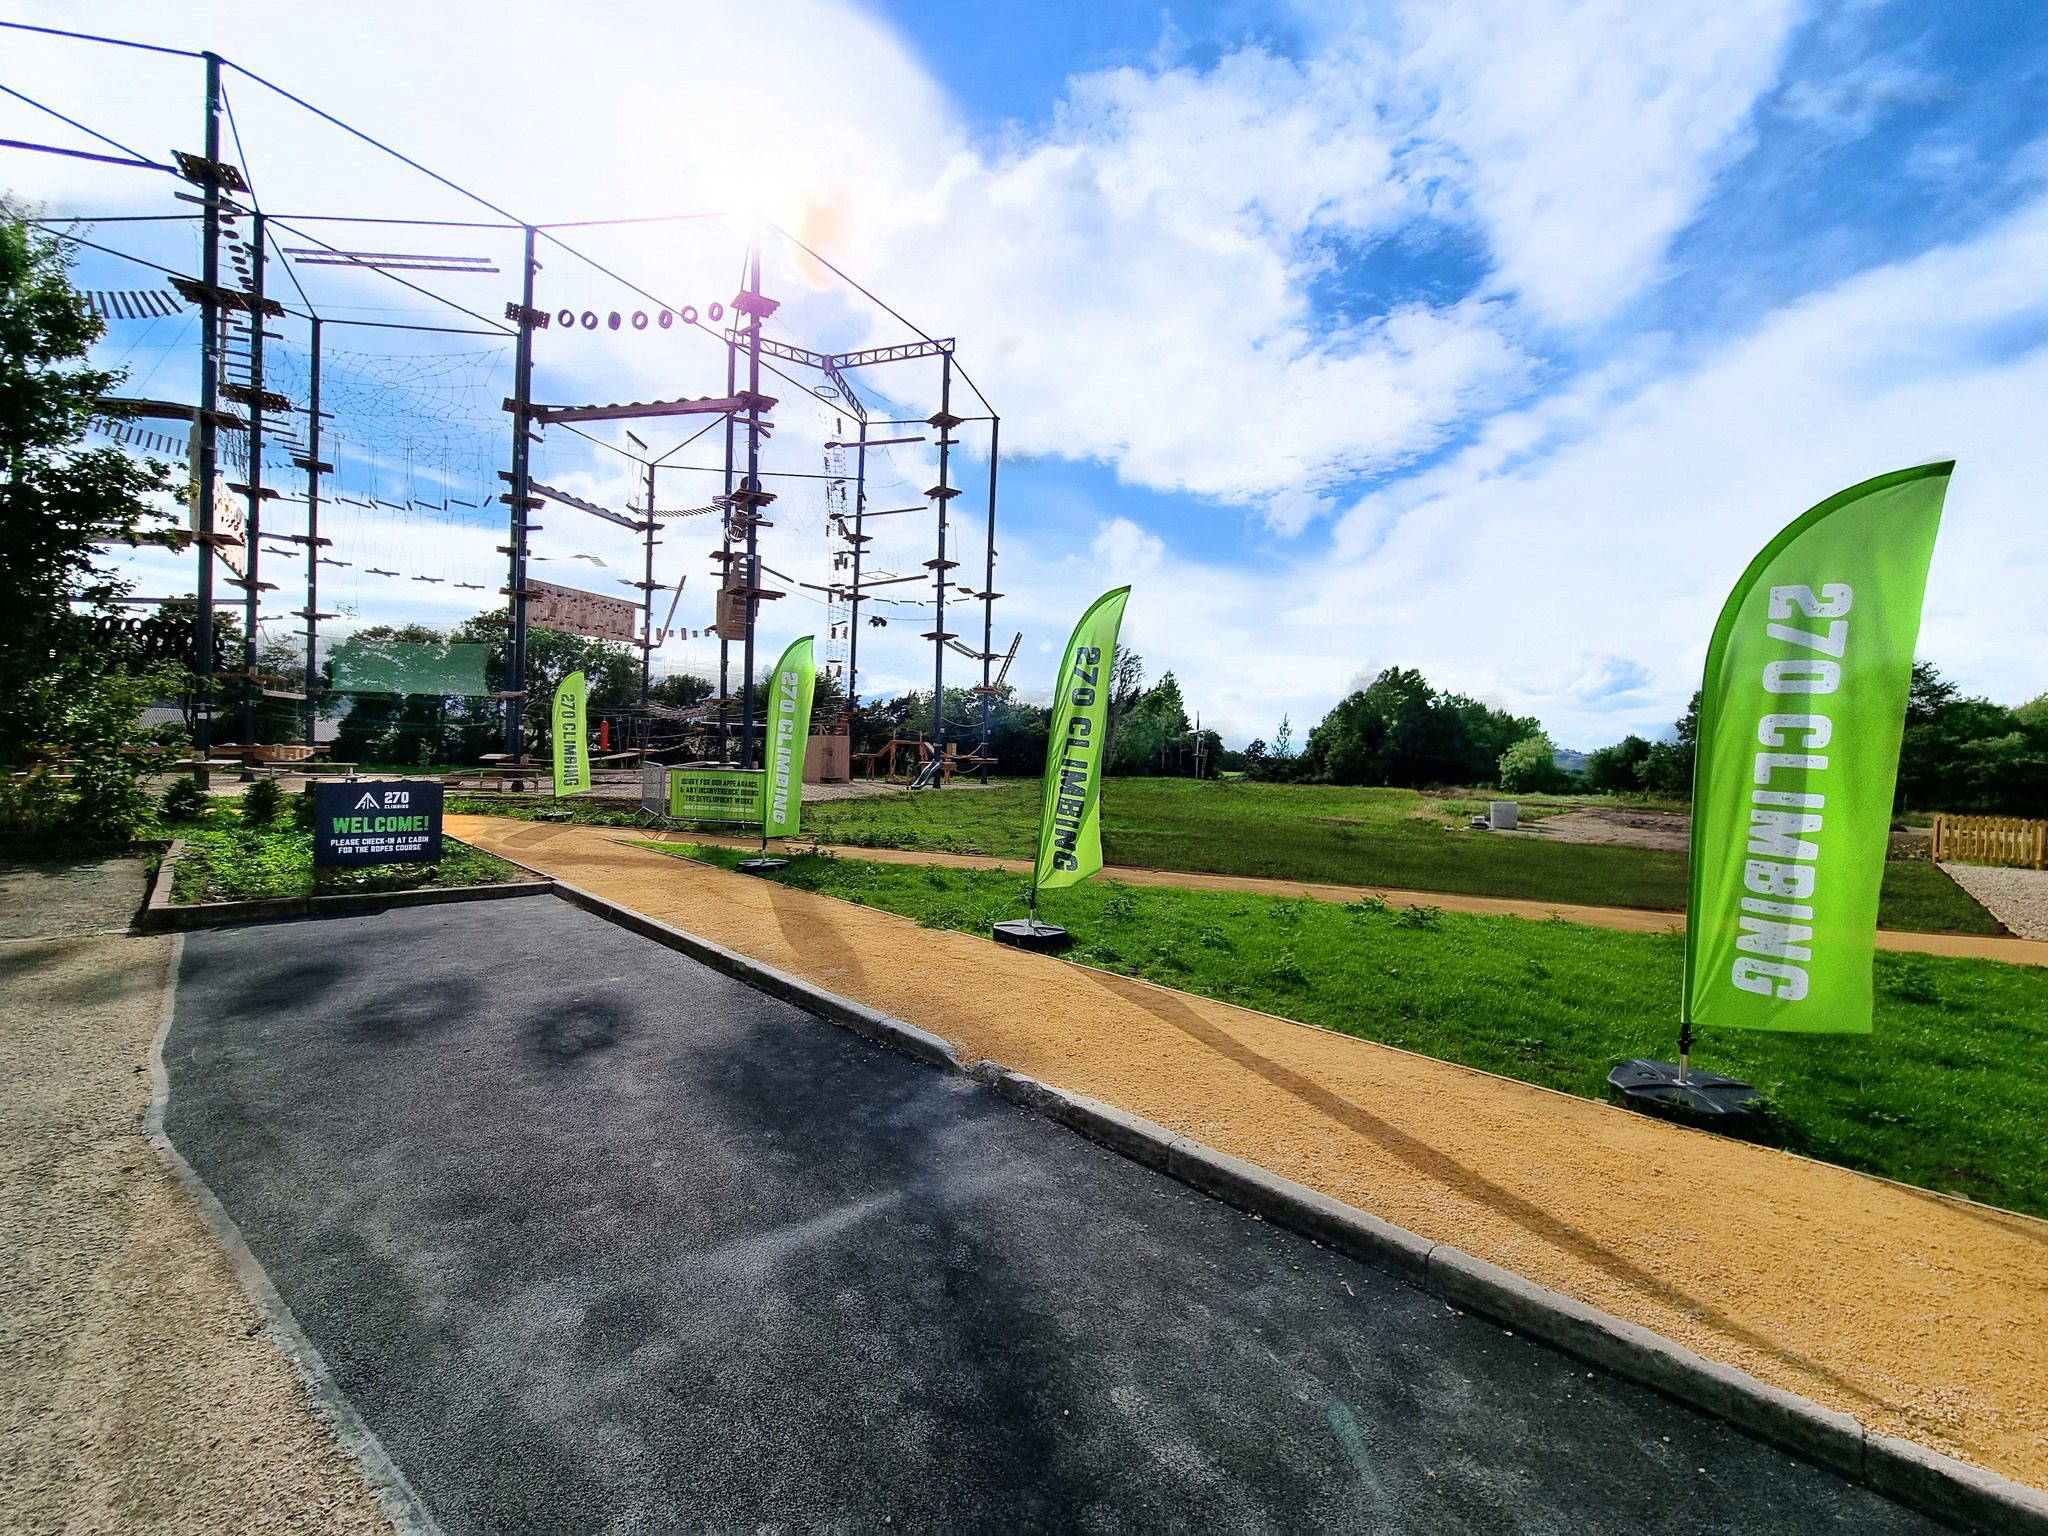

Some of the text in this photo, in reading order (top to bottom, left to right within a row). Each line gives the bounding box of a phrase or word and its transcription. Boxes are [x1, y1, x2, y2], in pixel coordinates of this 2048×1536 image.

[561, 693, 579, 787] 270 CLIMBING
[773, 671, 799, 825] 270 CLIMBING
[1052, 646, 1101, 872] 270 CLIMBING
[384, 791, 409, 804] 270
[1731, 583, 1853, 1001] 270 CLIMBING
[330, 836, 429, 847] PLEASE CHECK-IN AT CABIN
[333, 816, 429, 834] WELCOME!
[338, 844, 422, 854] FOR THE ROPES COURSE
